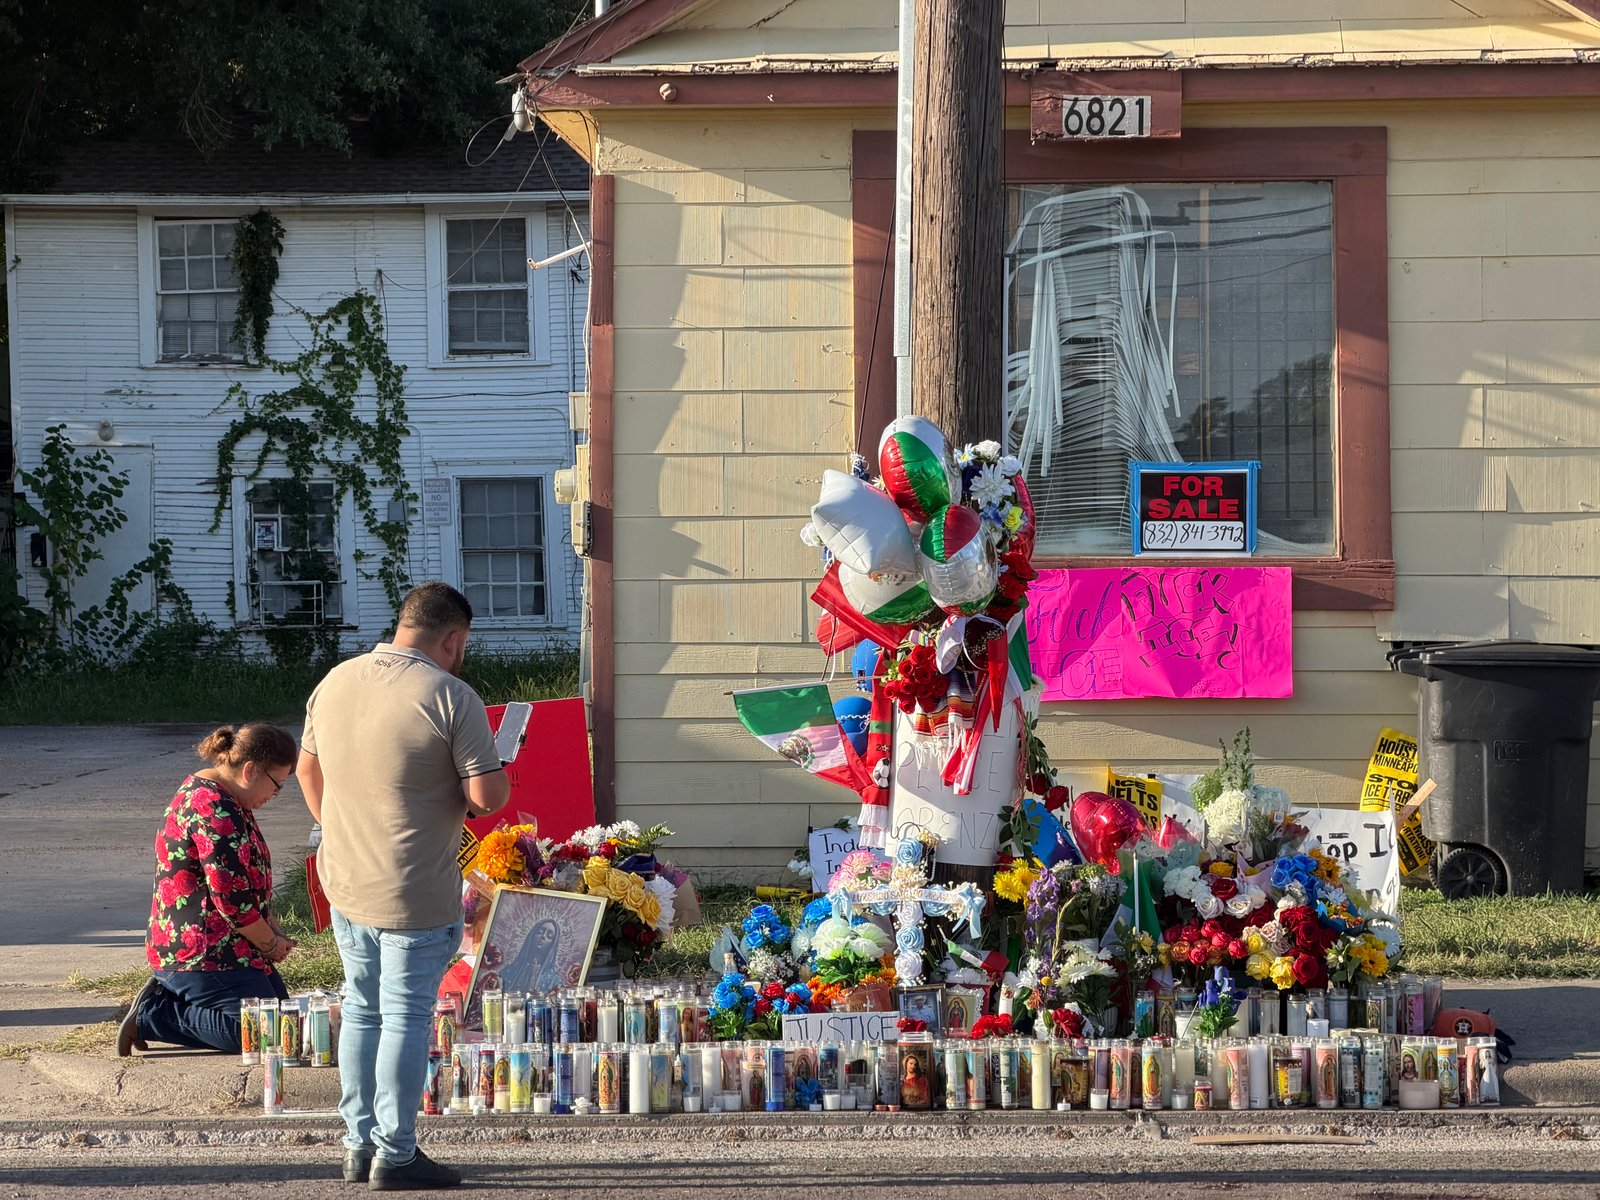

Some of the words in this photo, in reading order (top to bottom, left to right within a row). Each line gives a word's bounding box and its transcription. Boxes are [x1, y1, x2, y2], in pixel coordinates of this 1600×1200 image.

[1064, 96, 1146, 137] 6821
[1163, 475, 1224, 497] FOR
[1147, 498, 1240, 520] SALE
[1143, 520, 1178, 549] (832)
[1180, 523, 1245, 544] 841-3992
[34, 555, 43, 567] 4
[375, 659, 392, 668] BOSS
[1115, 779, 1146, 790] ICE
[1364, 784, 1382, 797] ICE
[1402, 825, 1427, 861] RTATION!
[785, 1015, 898, 1042] JUSTICE
